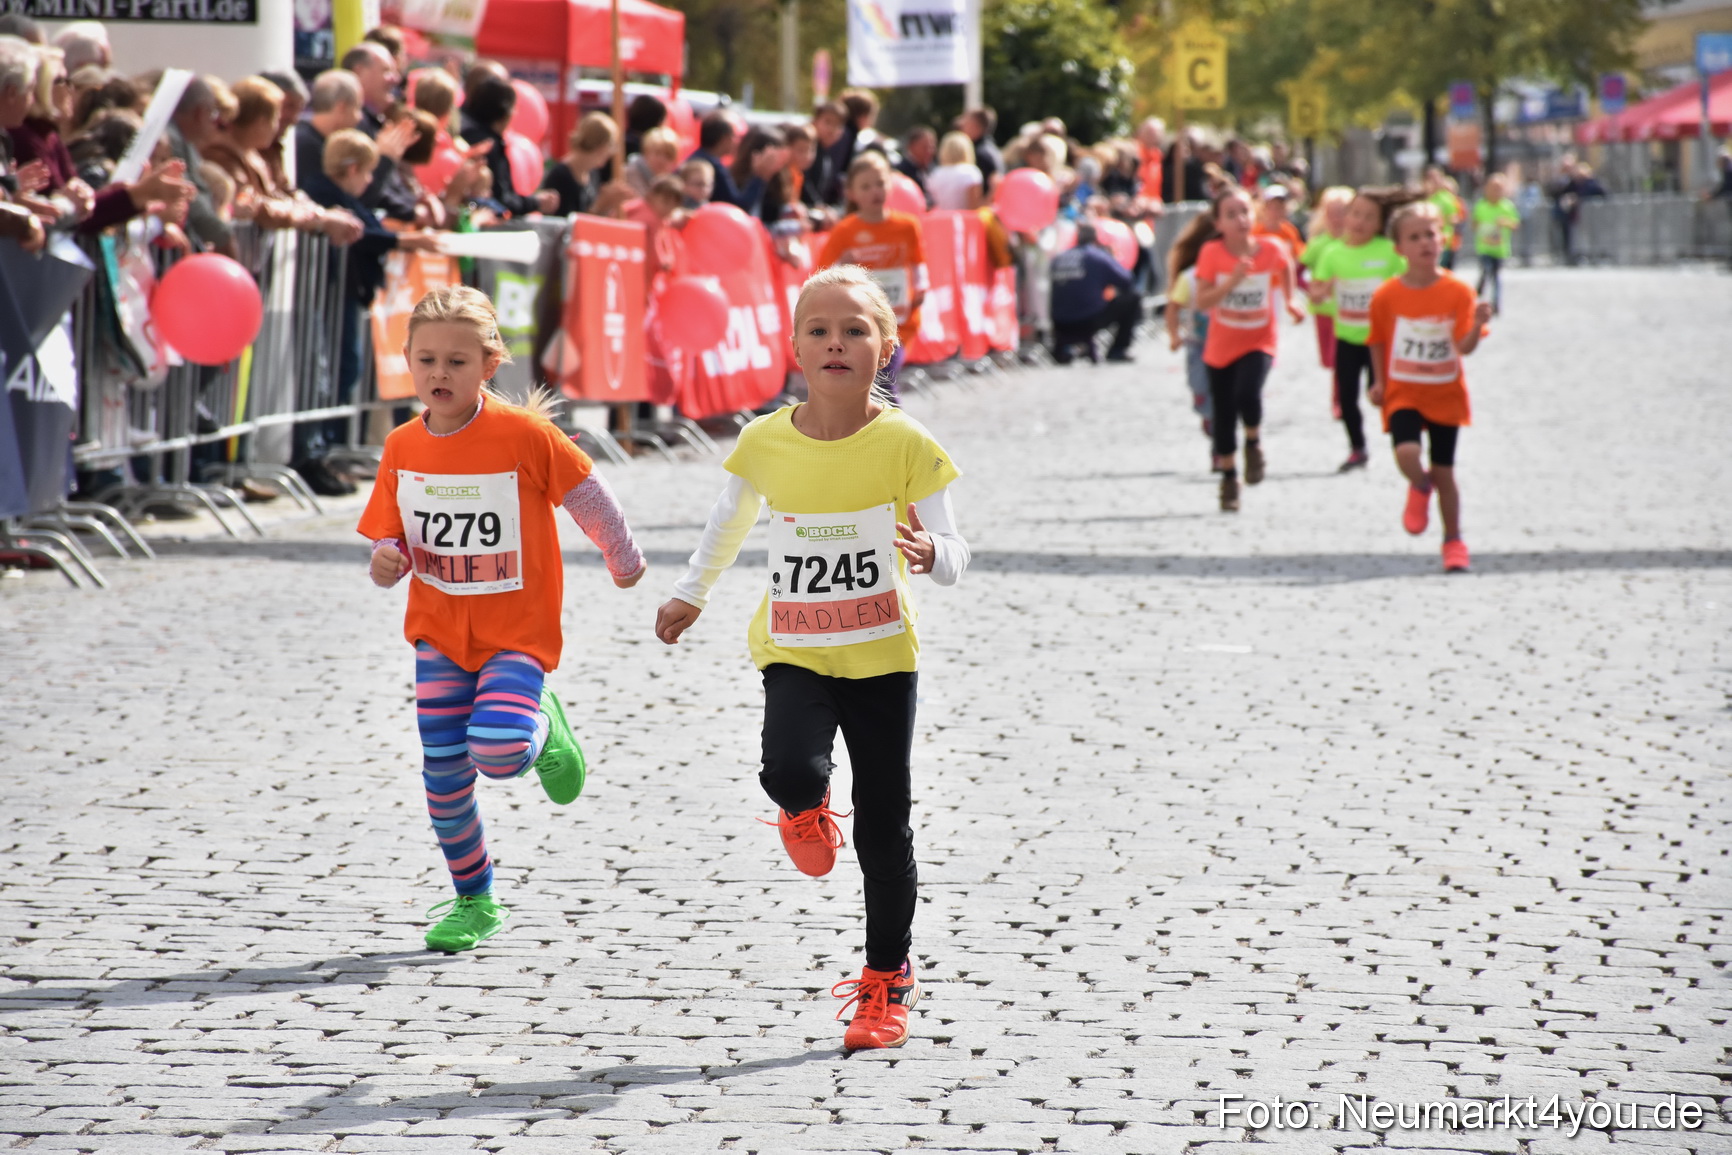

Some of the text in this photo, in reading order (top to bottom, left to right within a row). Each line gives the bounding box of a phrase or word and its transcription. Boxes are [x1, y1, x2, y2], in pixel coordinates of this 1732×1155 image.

[1187, 57, 1212, 92] C
[1402, 336, 1451, 360] 7125
[437, 486, 480, 496] BOCK
[413, 510, 501, 548] 7279
[808, 525, 857, 537] BOCK
[784, 549, 879, 594] 7245
[774, 599, 893, 631] MADLEN
